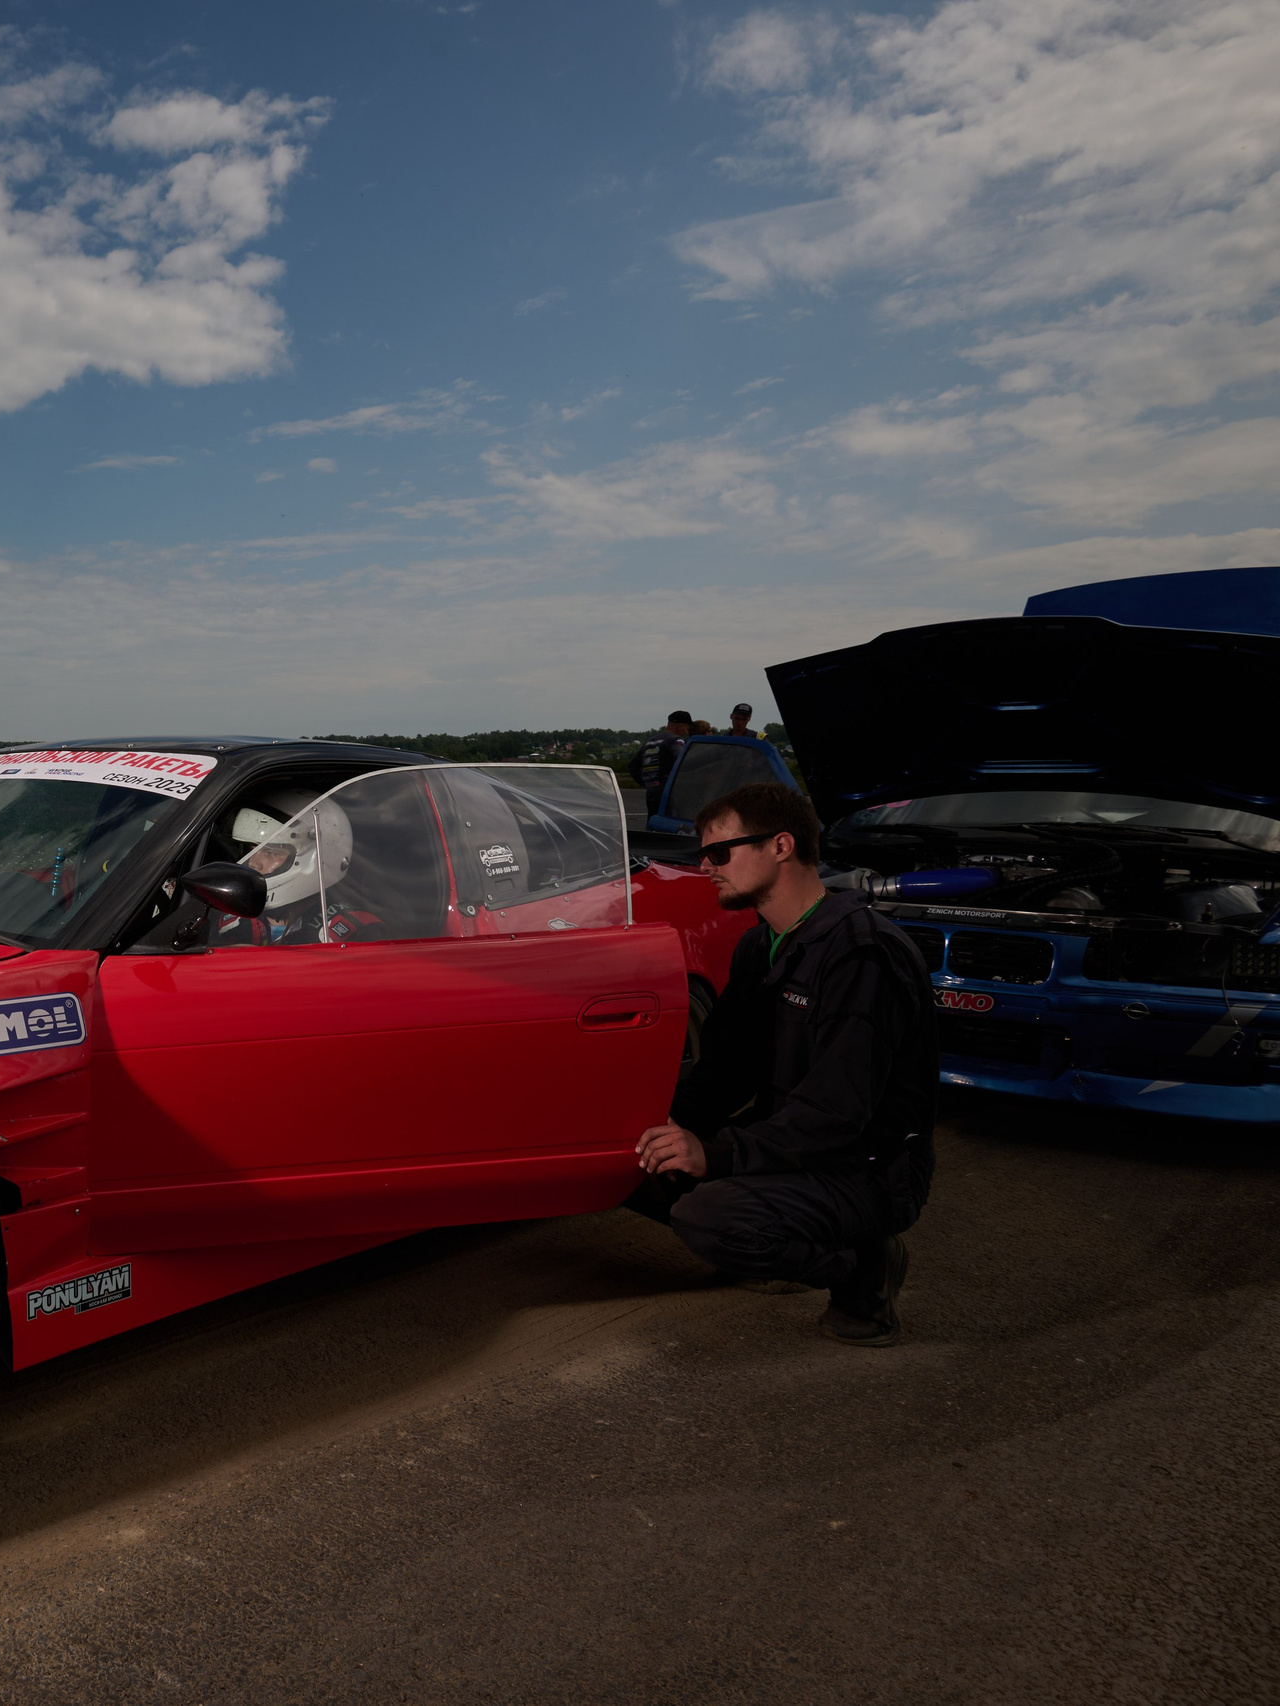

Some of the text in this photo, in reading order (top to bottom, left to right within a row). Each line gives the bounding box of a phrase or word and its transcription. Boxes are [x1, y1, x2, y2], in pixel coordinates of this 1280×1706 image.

[108, 752, 214, 779] РАКЕТЫ
[102, 772, 196, 795] СЕЗОН 2025
[926, 907, 1007, 919] ZENICH MOTORSPORT
[28, 1264, 130, 1319] PONULYAM
